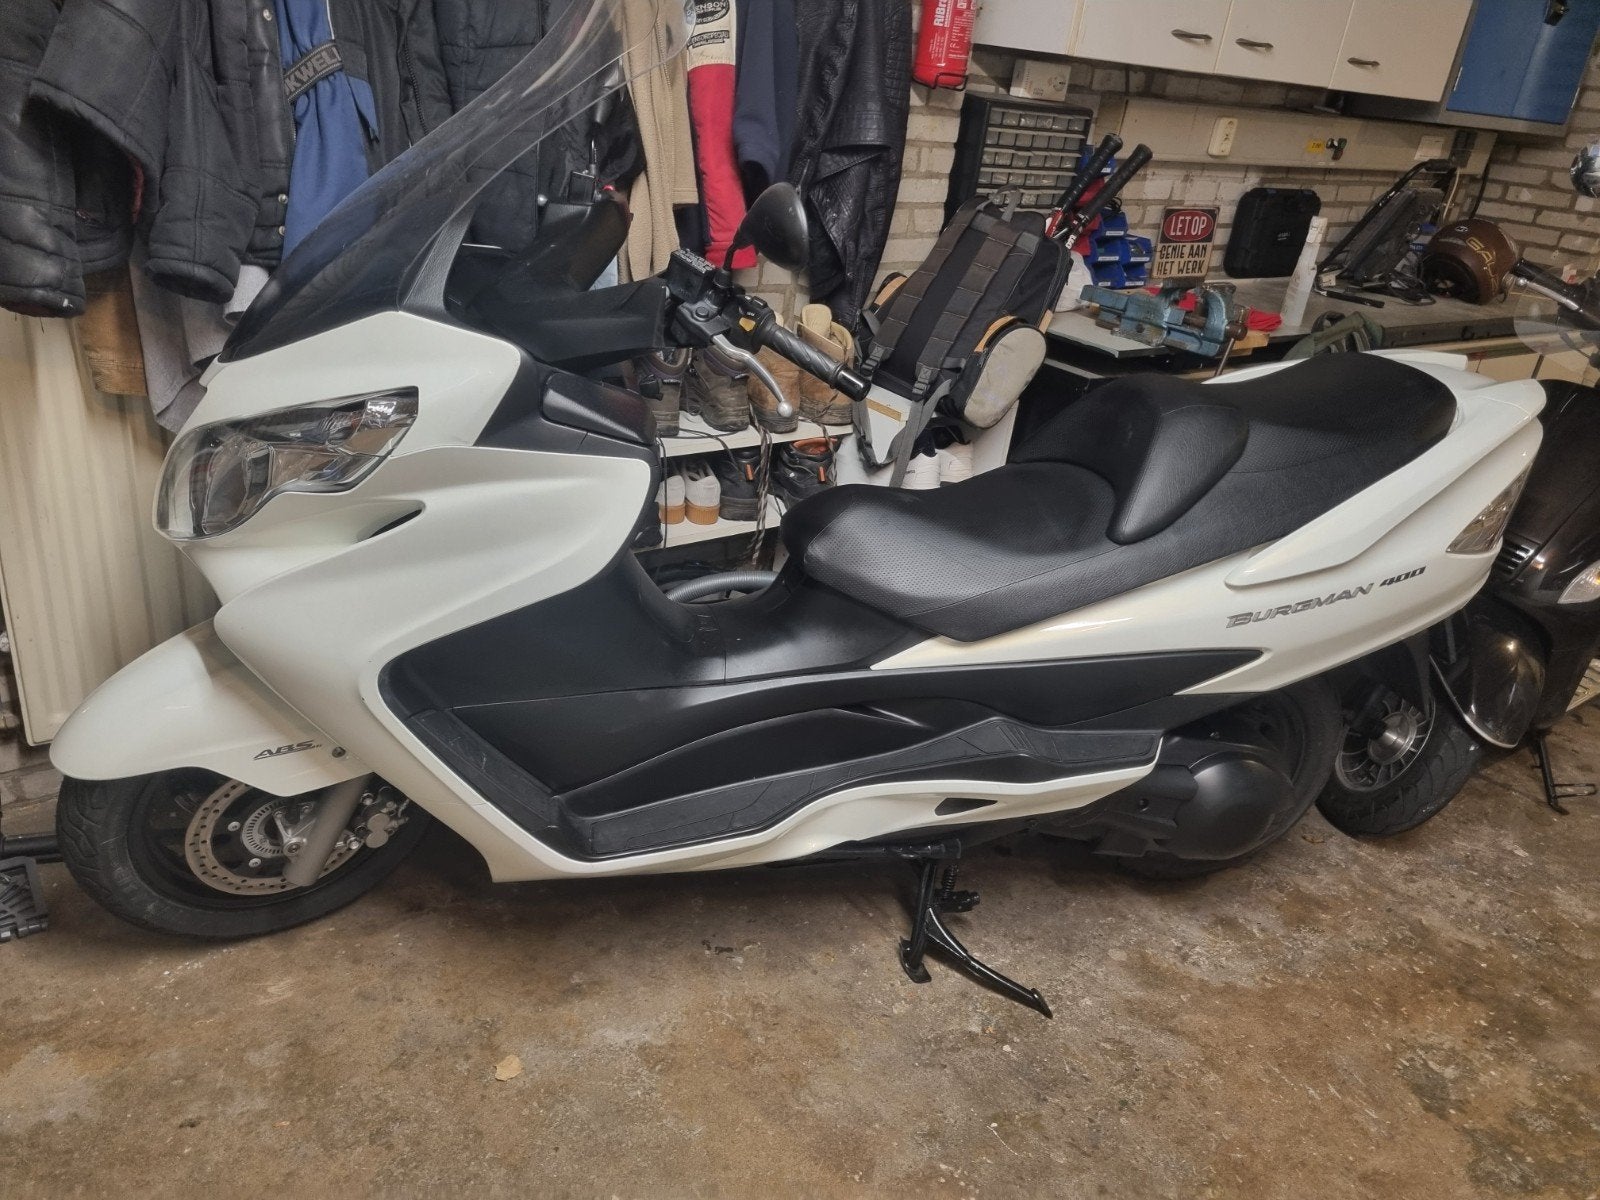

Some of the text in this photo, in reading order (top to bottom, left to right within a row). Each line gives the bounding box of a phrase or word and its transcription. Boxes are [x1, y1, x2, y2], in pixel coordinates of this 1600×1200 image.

[1160, 244, 1208, 260] GENIE AAN
[1157, 260, 1204, 275] HET WERK
[1226, 566, 1426, 628] BURGMAN 400
[253, 740, 314, 760] ABS
